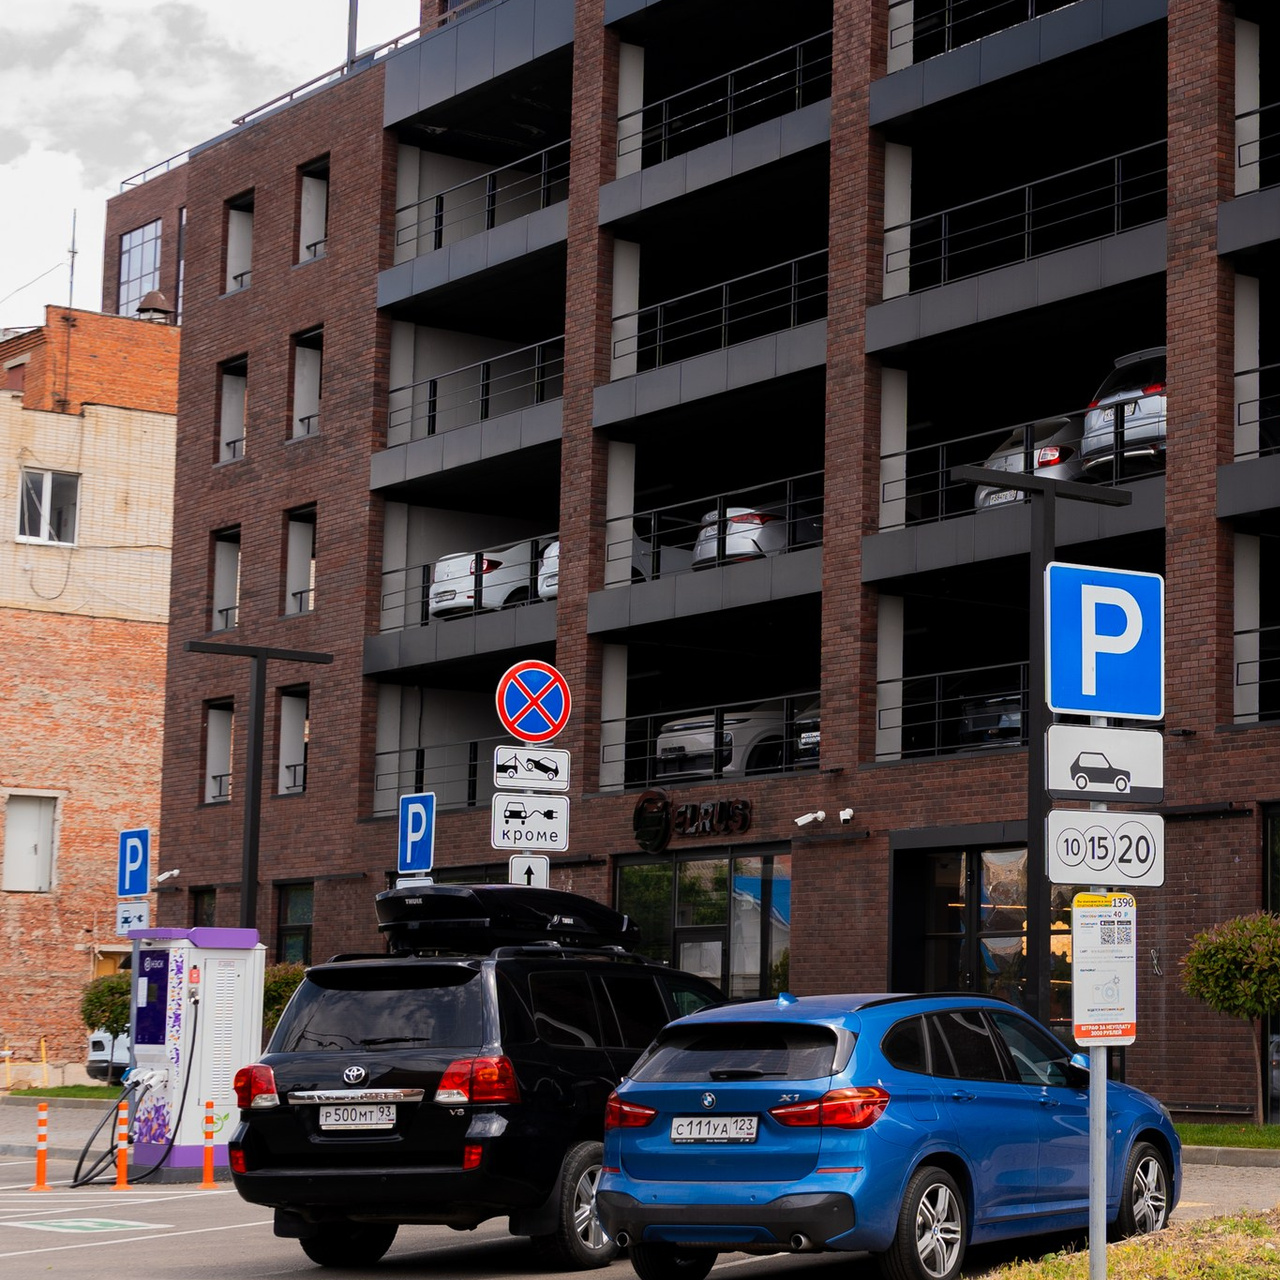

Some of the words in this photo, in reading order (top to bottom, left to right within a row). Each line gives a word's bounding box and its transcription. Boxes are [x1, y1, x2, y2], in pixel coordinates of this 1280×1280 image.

[1081, 583, 1143, 696] P
[406, 803, 427, 864] P
[502, 827, 559, 846] кроме
[1063, 837, 1081, 857] 10
[1088, 835, 1109, 860] 15
[1117, 834, 1151, 865] 20
[124, 837, 143, 890] P
[1112, 897, 1134, 908] 1390
[778, 1093, 800, 1102] X1
[449, 1108, 466, 1117] V8
[732, 1118, 754, 1131] 123
